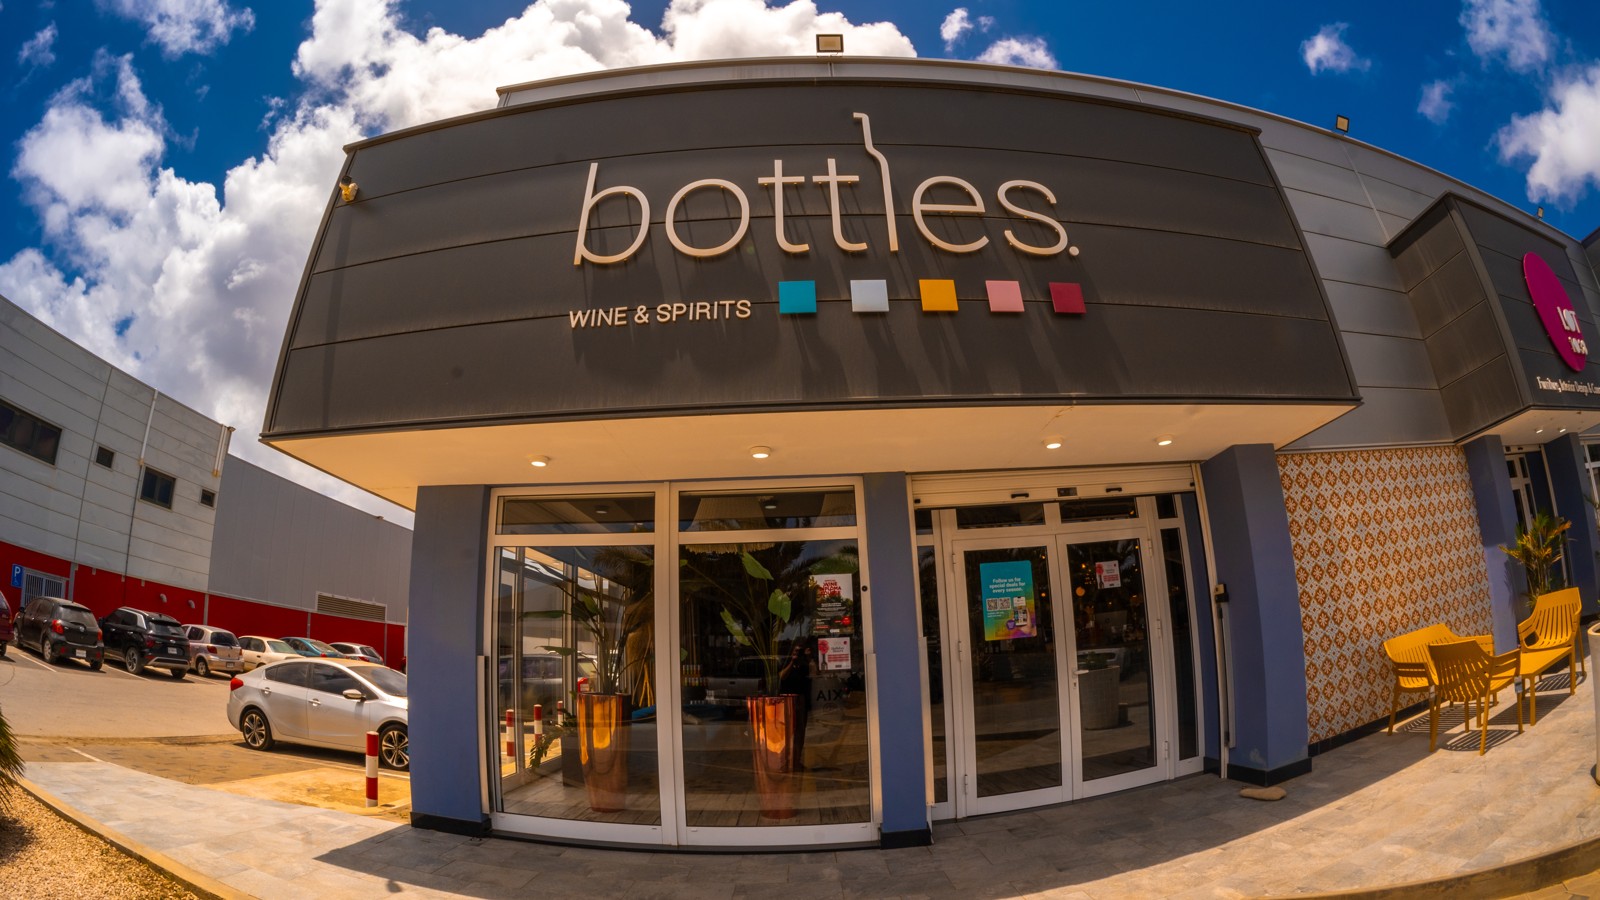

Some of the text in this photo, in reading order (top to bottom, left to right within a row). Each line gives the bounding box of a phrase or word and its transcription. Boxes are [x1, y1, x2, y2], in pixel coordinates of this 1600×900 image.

[573, 112, 1080, 265] bottles.
[569, 300, 752, 329] WINE & SPIRITS
[1557, 306, 1581, 334] LOT
[14, 566, 21, 577] P
